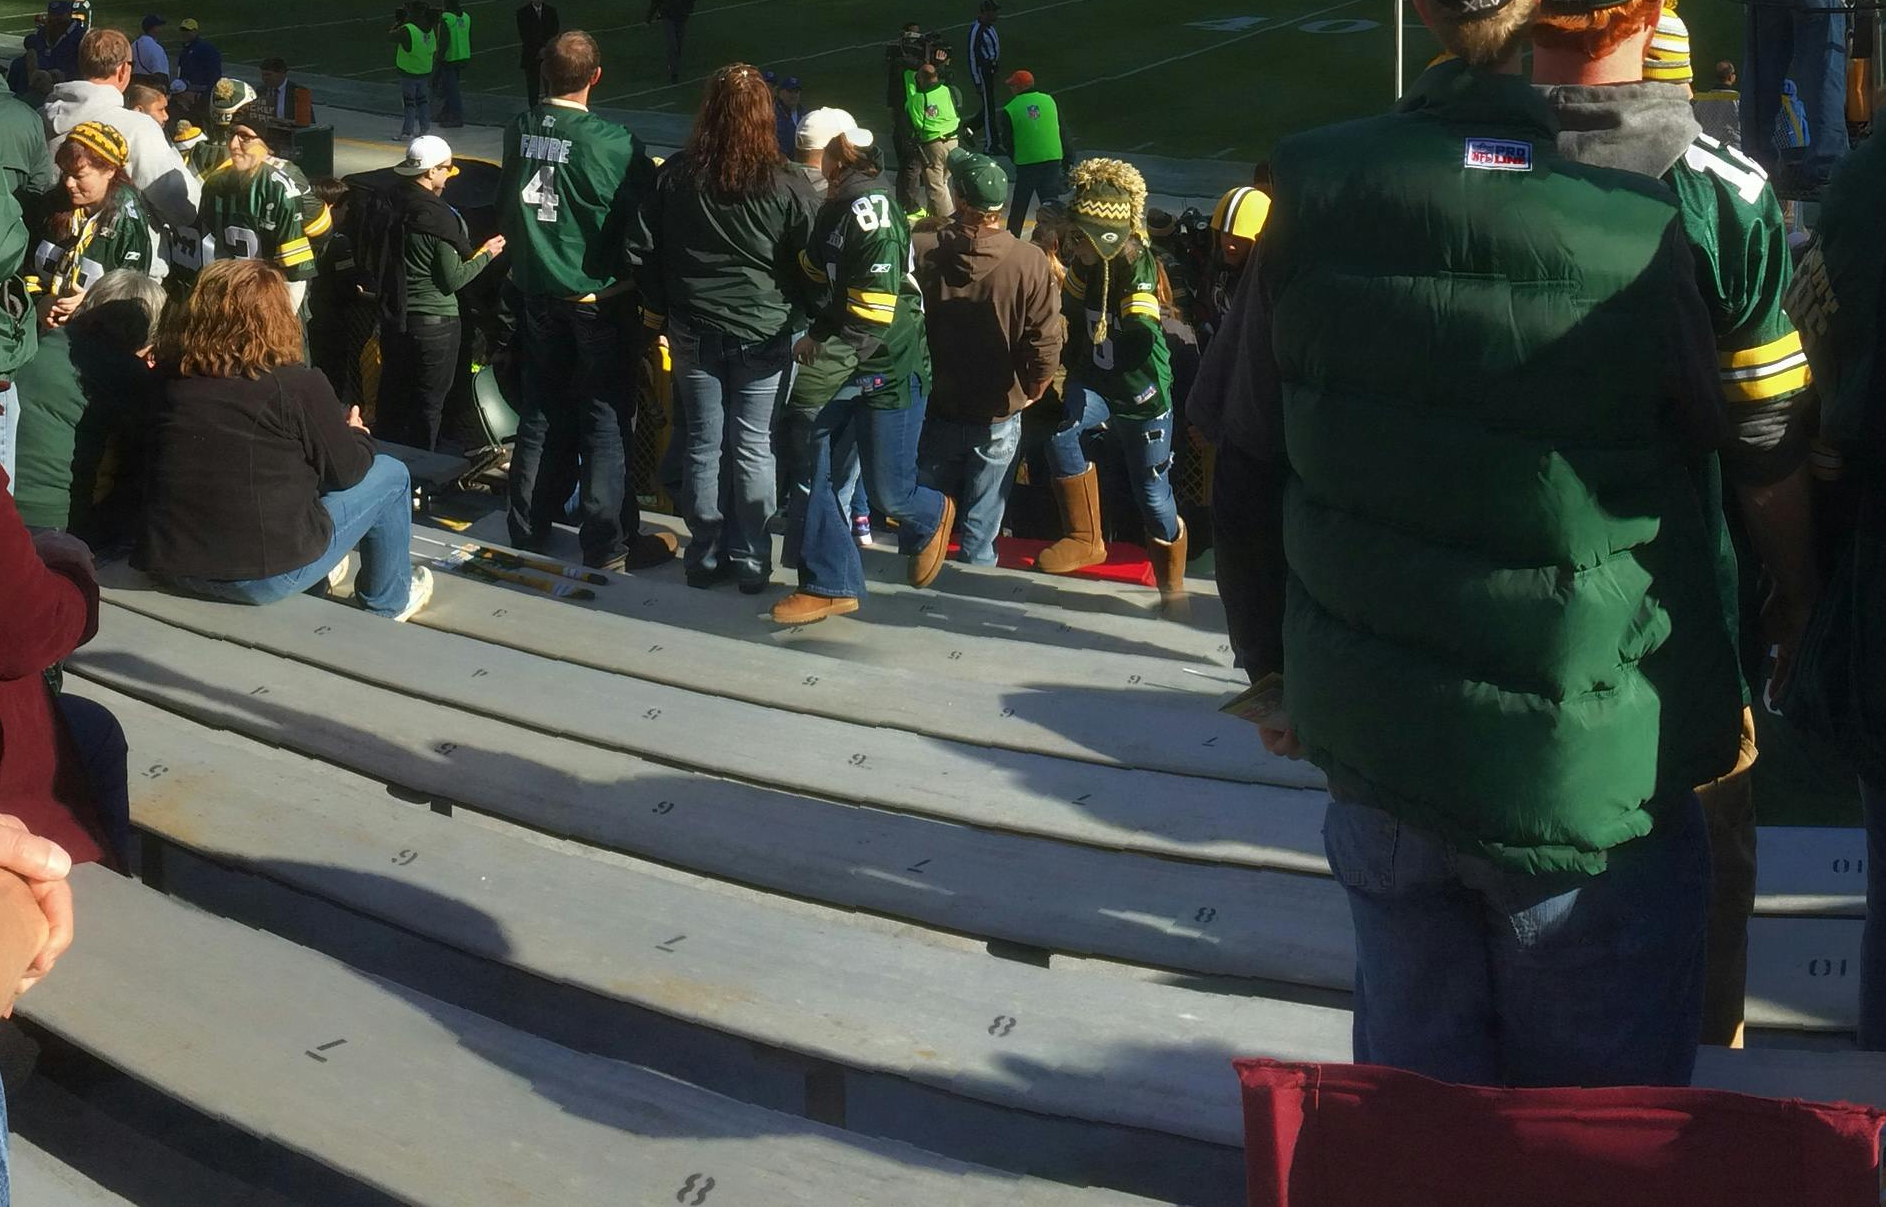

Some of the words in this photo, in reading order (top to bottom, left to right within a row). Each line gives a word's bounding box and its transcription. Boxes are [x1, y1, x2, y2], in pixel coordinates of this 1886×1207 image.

[520, 133, 573, 164] FAVRE
[521, 166, 560, 222] 4
[851, 194, 892, 232] 87
[1808, 959, 1848, 977] 10
[987, 1014, 1017, 1038] 8
[676, 1172, 716, 1207] 8
